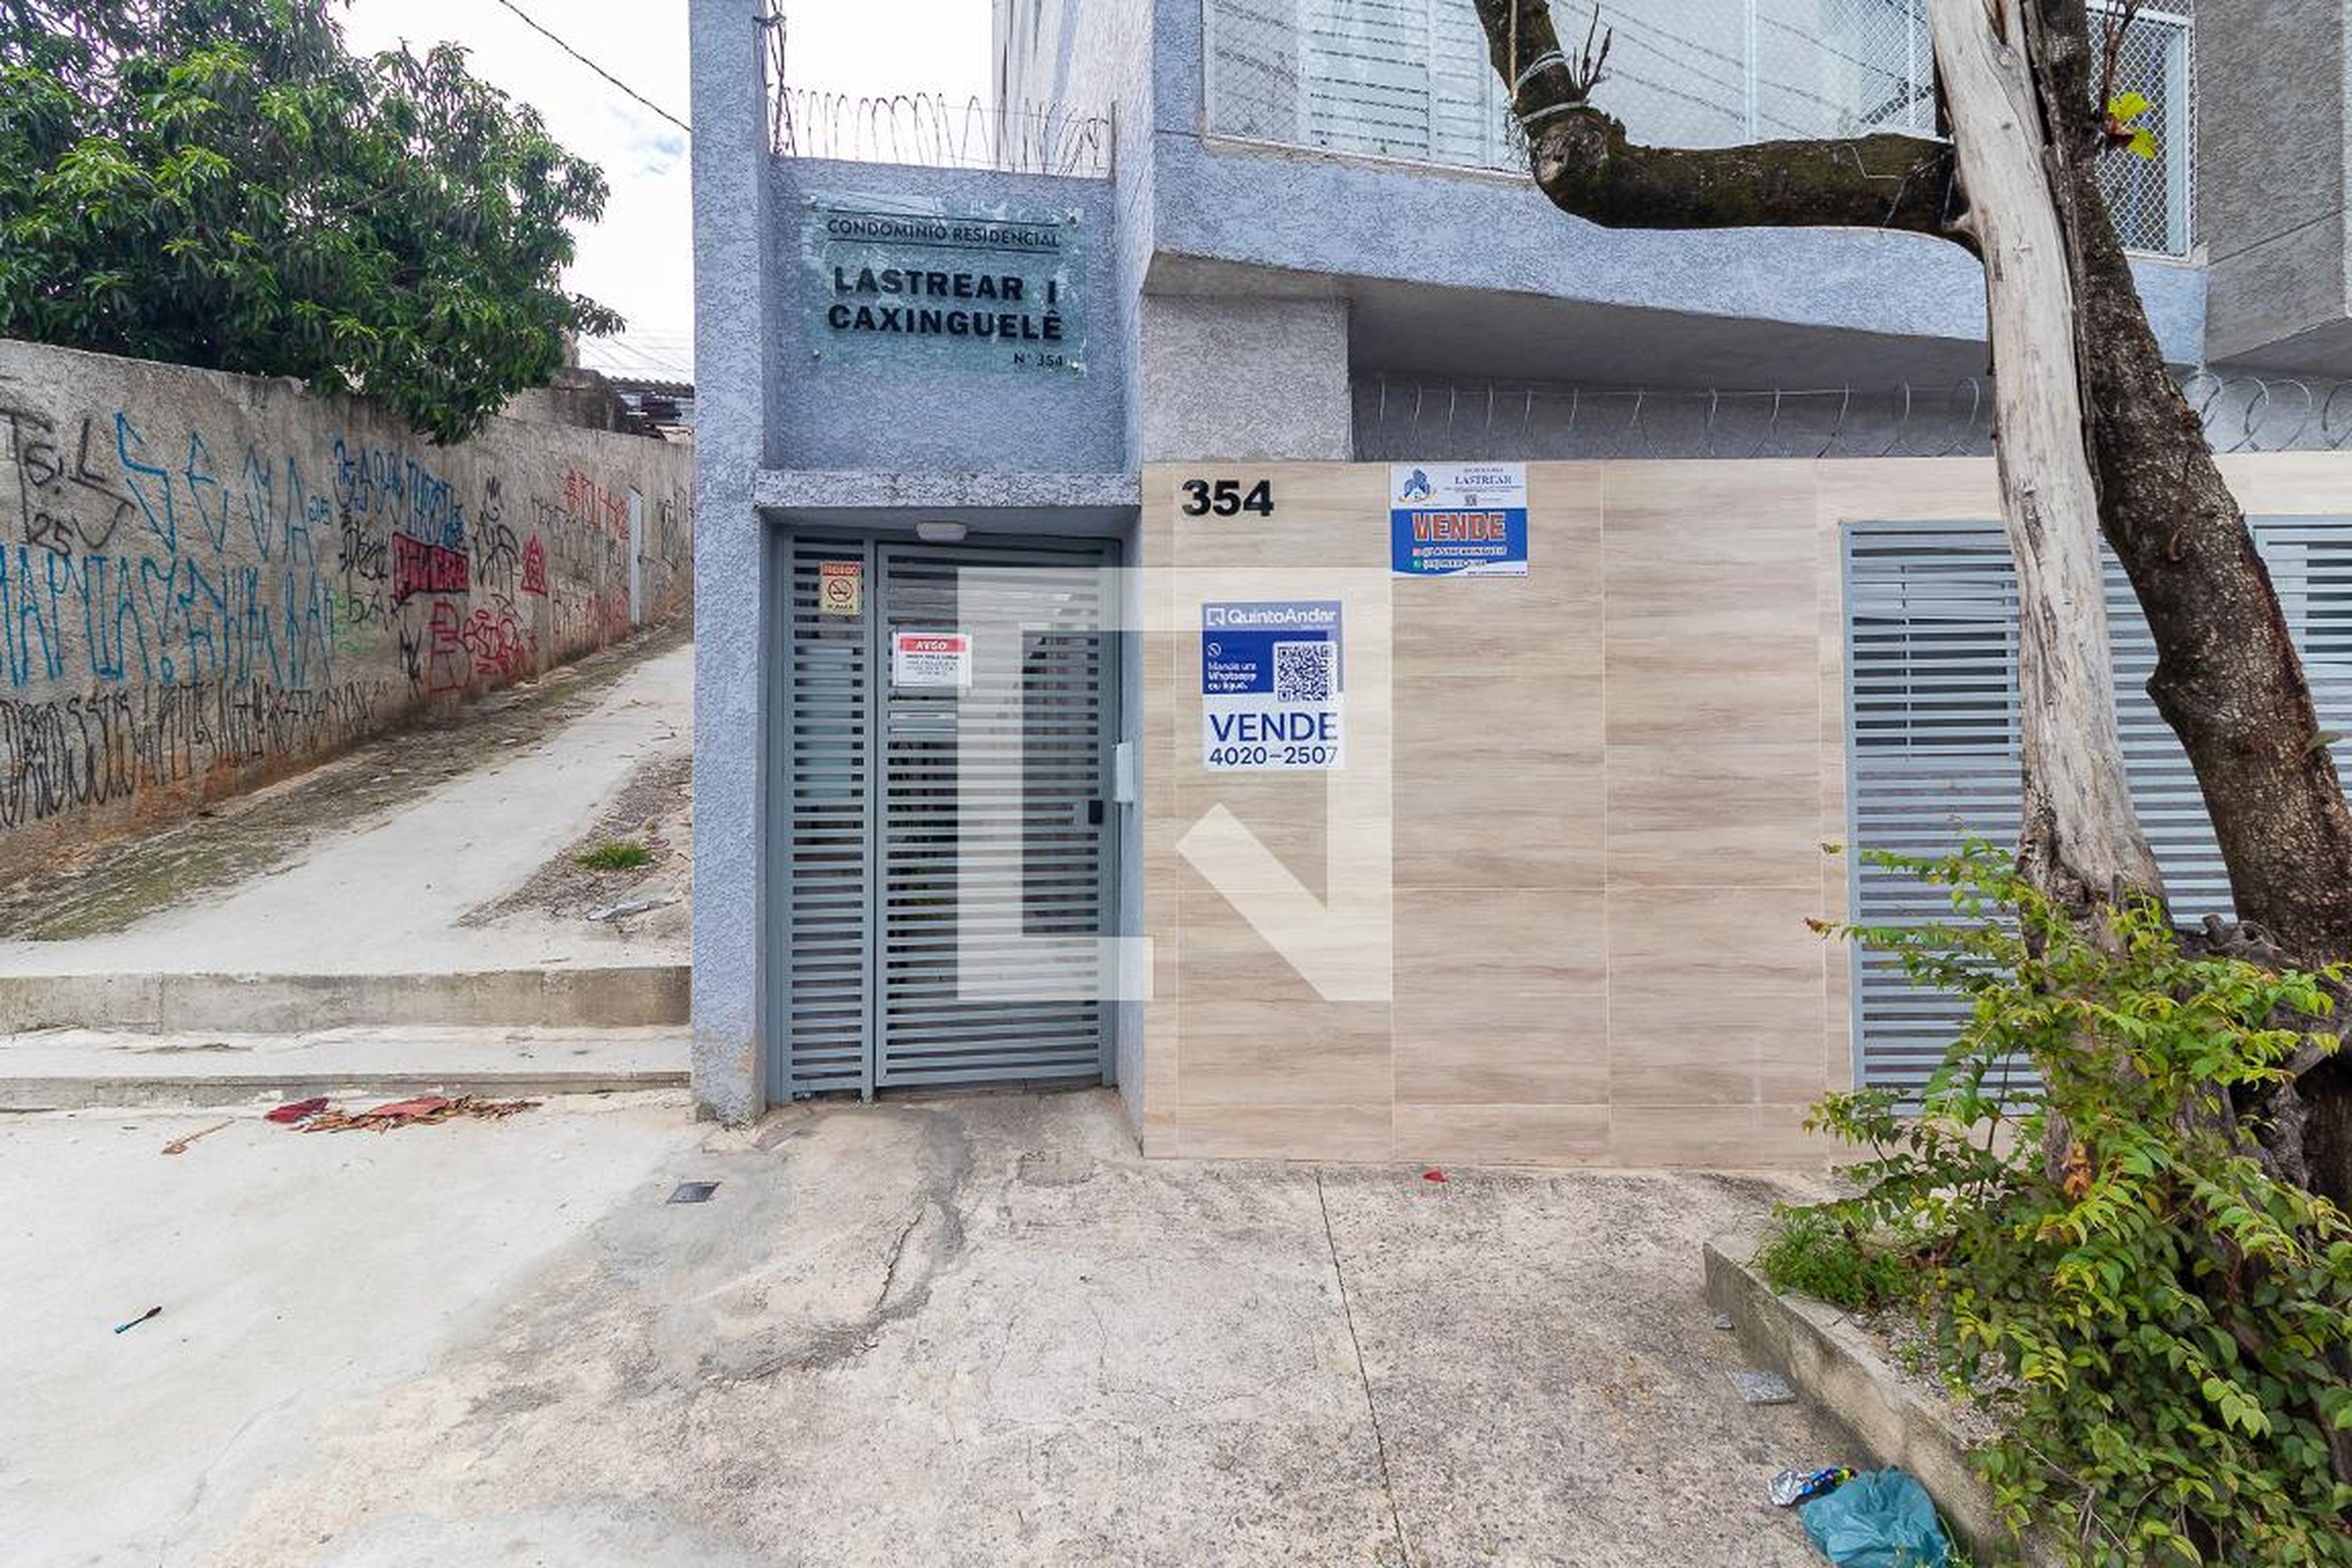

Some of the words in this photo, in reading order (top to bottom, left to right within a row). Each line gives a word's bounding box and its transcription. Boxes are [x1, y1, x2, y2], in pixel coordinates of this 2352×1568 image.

[952, 227, 1060, 247] RESIDENCIAL
[834, 266, 1023, 301] LASTREAR
[827, 304, 1062, 340] CAXINGUELÊ
[1036, 353, 1063, 367] 354
[1182, 479, 1275, 517] 354
[1412, 511, 1506, 541] VENDE
[1227, 608, 1337, 625] QuintoAndar
[1208, 712, 1338, 742] VENDE
[1209, 746, 1338, 765] 4020-2507
